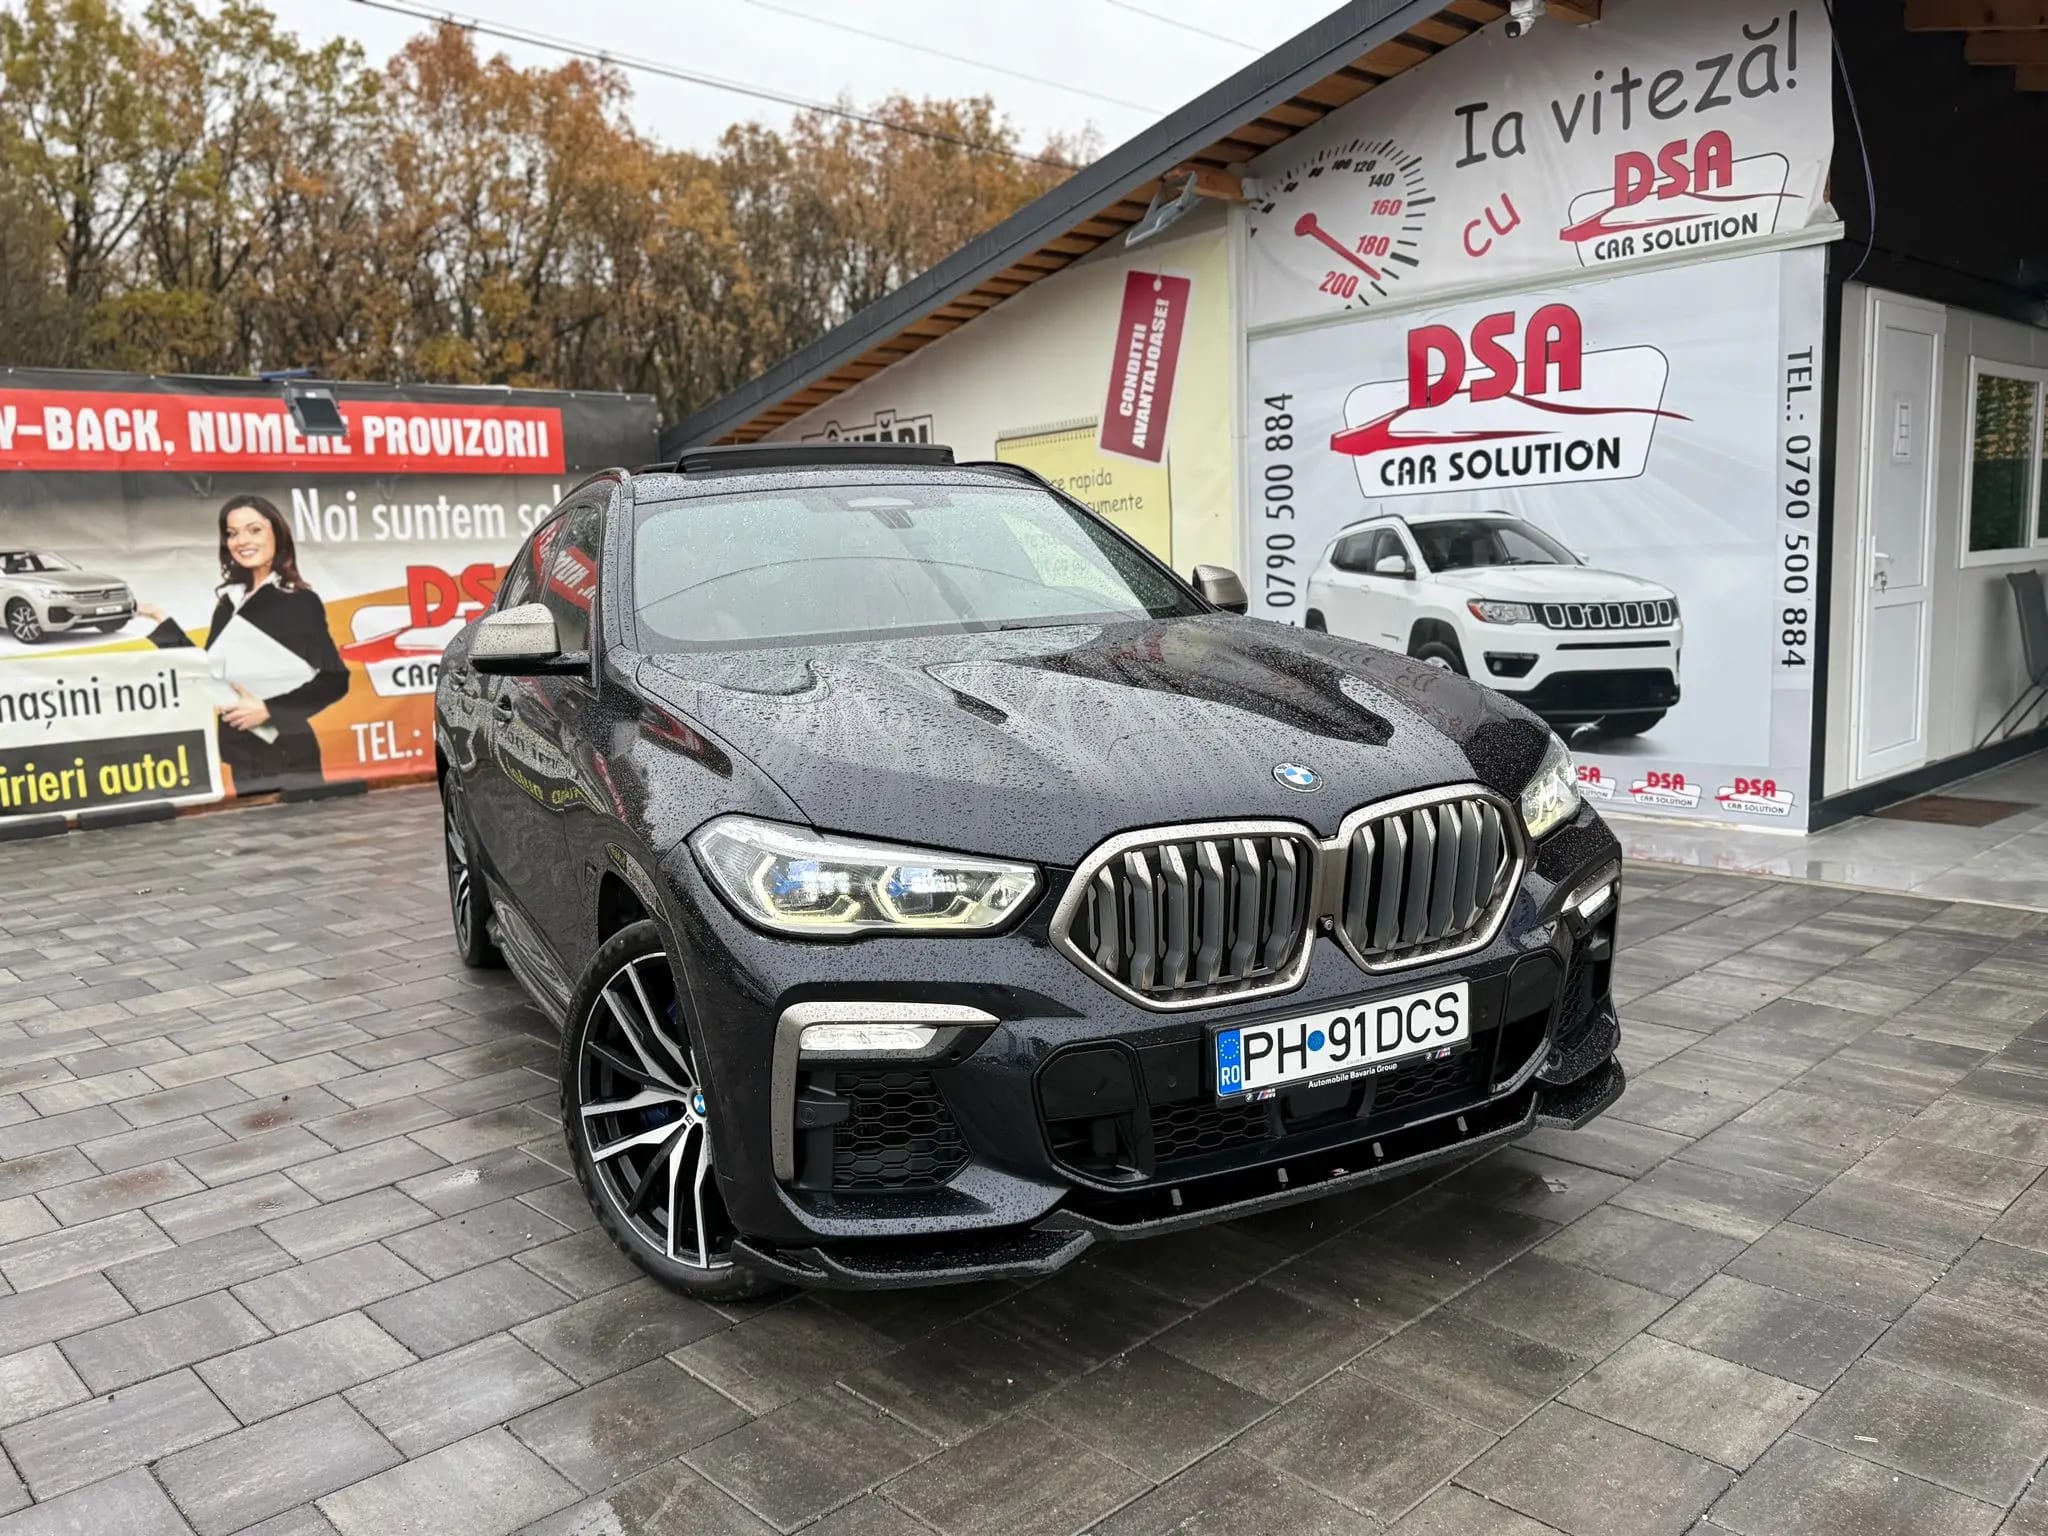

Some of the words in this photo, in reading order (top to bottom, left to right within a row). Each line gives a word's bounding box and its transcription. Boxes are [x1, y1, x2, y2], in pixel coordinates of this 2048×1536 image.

[1454, 101, 1526, 168] Ia
[1550, 9, 1798, 144] viteză!
[1353, 160, 1376, 173] 120
[1368, 172, 1395, 187] 140
[1614, 129, 1733, 208] DSA
[1370, 199, 1402, 216] 160
[1463, 192, 1521, 257] cu
[1355, 235, 1390, 257] 180
[1594, 236, 1634, 260] CAR
[1642, 212, 1758, 253] SOLUTION
[1318, 270, 1359, 299] 200
[1408, 303, 1582, 410] DSA
[363, 416, 548, 457] PROVIZORII
[1264, 393, 1294, 452] 884
[1069, 466, 1112, 494] rapida
[1380, 453, 1437, 487] CAR
[1449, 436, 1621, 482] SOLUTION
[1785, 434, 1811, 519] 0790
[1265, 463, 1295, 520] 500
[292, 488, 359, 542] Noi
[372, 495, 506, 540] suntem
[1266, 533, 1296, 608] 0790
[1783, 533, 1810, 594] 500
[1781, 606, 1808, 668] 884
[116, 668, 180, 712] noi!
[100, 745, 190, 796] auto!
[1647, 772, 1685, 790] DSA
[1734, 777, 1777, 797] DSA
[1656, 796, 1693, 806] SOLUTION
[1744, 801, 1785, 814] SOLUTION
[1221, 1065, 1240, 1086] RO
[1307, 1072, 1349, 1088] Automobile
[1350, 1068, 1376, 1080] Bavaria
[1376, 1063, 1398, 1074] Group
